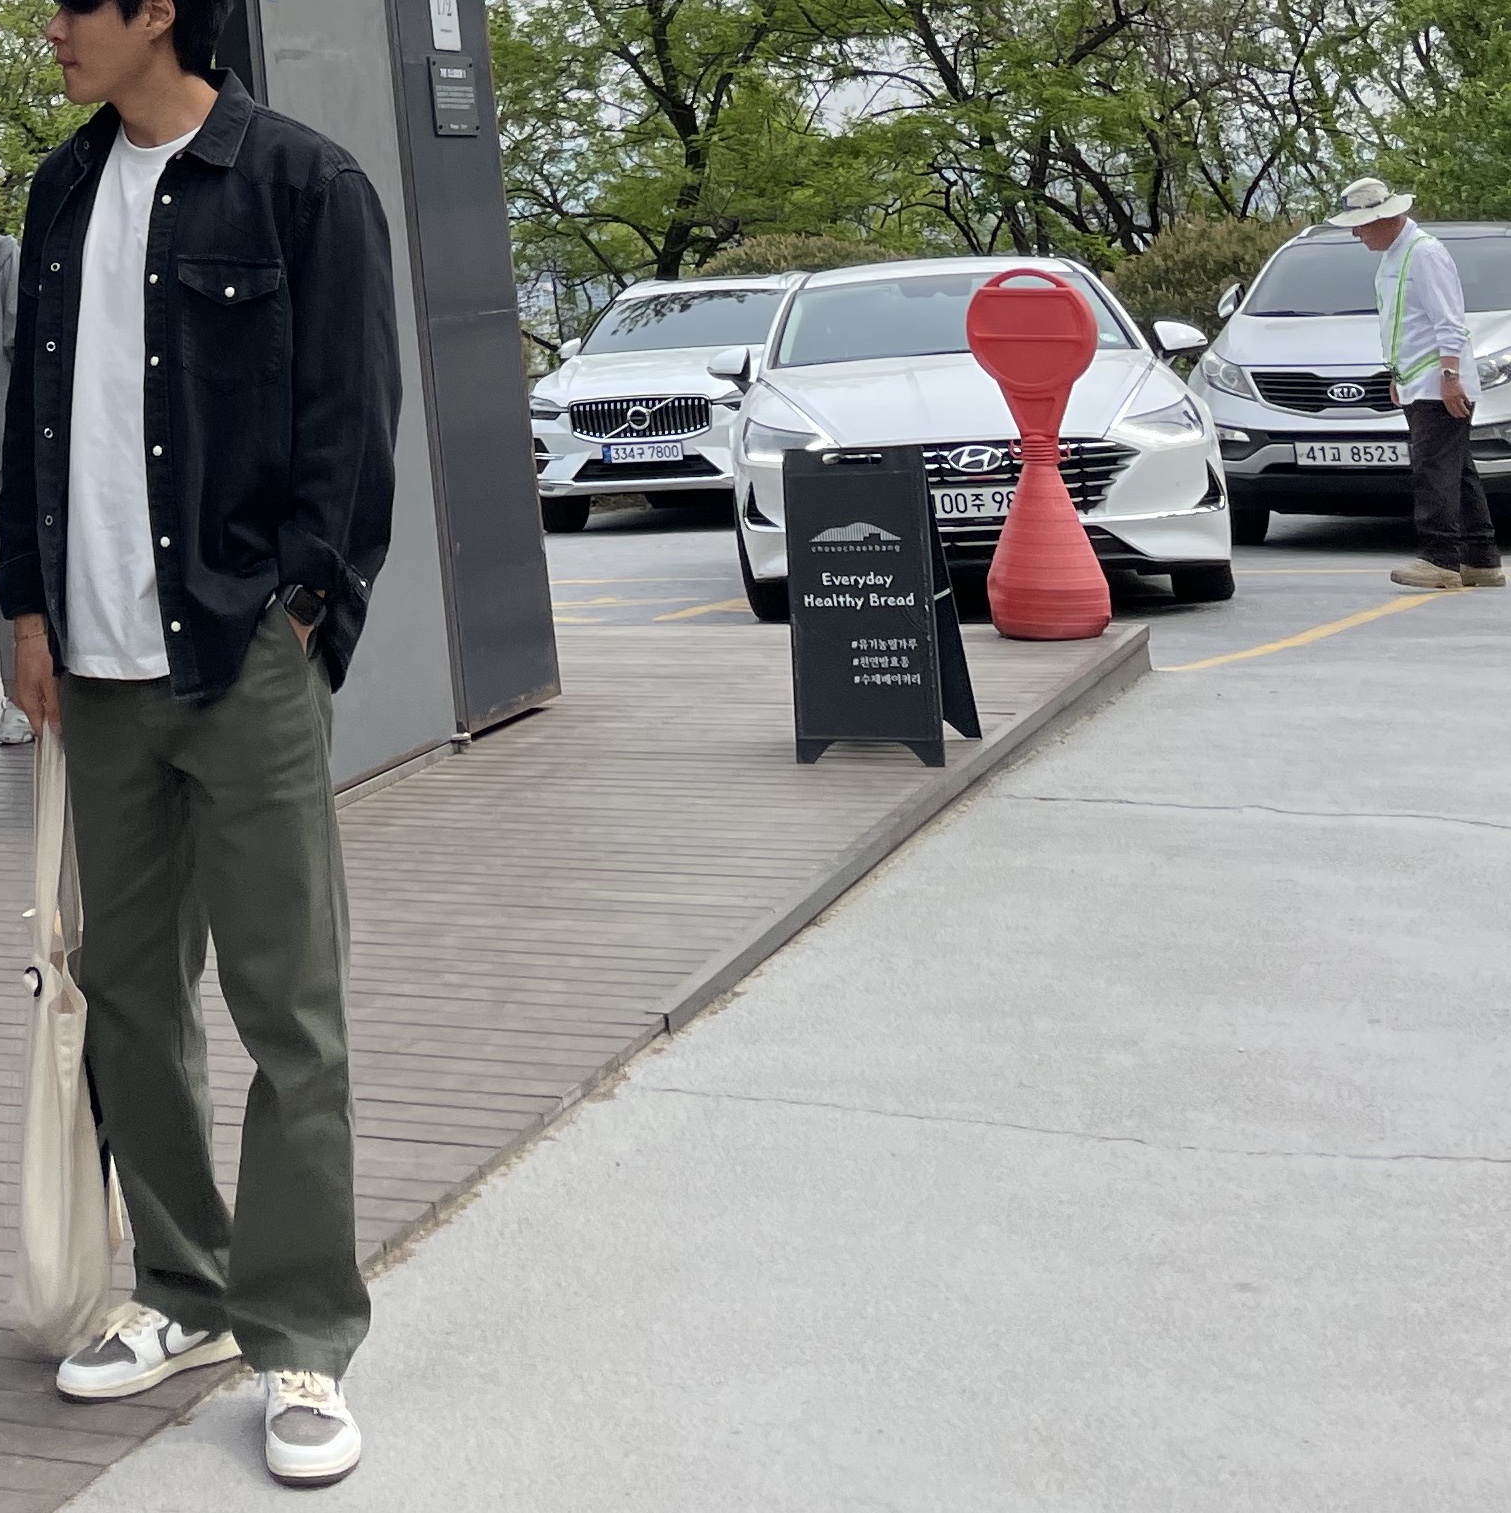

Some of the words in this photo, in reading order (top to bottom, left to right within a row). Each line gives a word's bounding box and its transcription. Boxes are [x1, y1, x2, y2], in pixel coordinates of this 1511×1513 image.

[1333, 387, 1358, 398] KIA
[612, 447, 645, 461] 334구
[647, 445, 679, 459] 7800
[1350, 446, 1399, 462] 8523
[821, 571, 893, 589] Everyday
[803, 593, 864, 610] Healthy
[869, 592, 915, 607] Bread
[851, 638, 918, 651] #유기농밀가루
